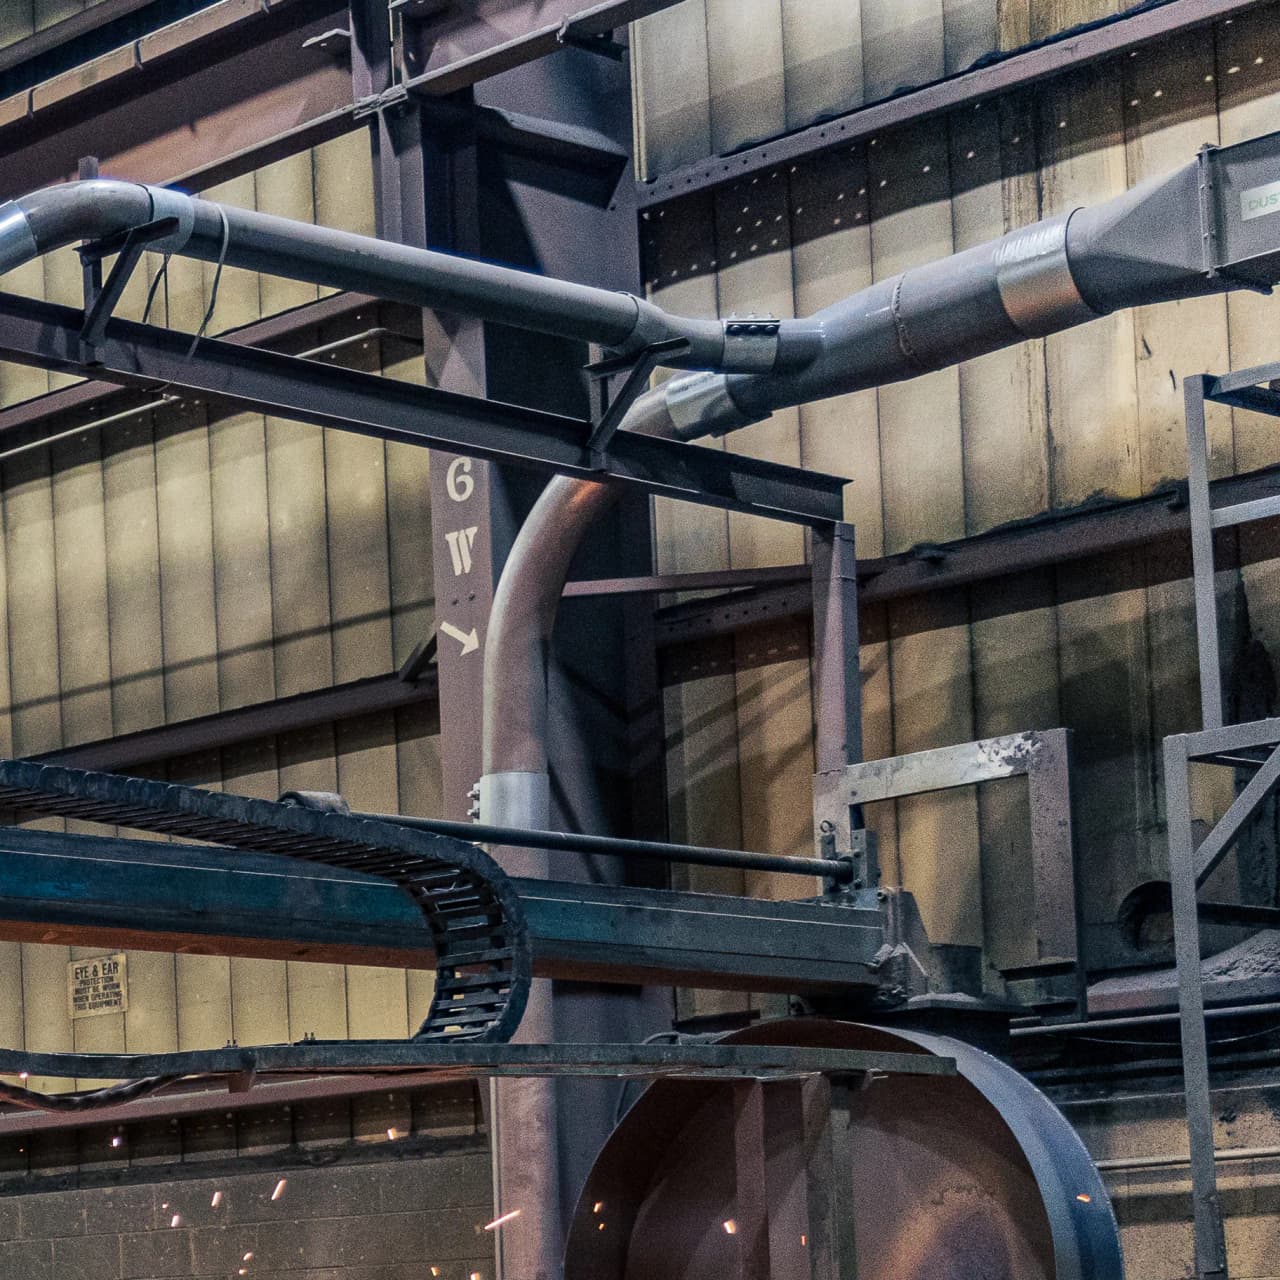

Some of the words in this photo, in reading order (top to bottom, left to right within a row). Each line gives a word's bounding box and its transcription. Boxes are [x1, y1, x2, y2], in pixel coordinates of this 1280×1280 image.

[75, 966, 88, 979] EYE
[92, 964, 98, 977] &
[102, 961, 119, 975] EAR
[91, 990, 122, 1001] OPERATING
[89, 999, 121, 1010] EQUIPMENT
